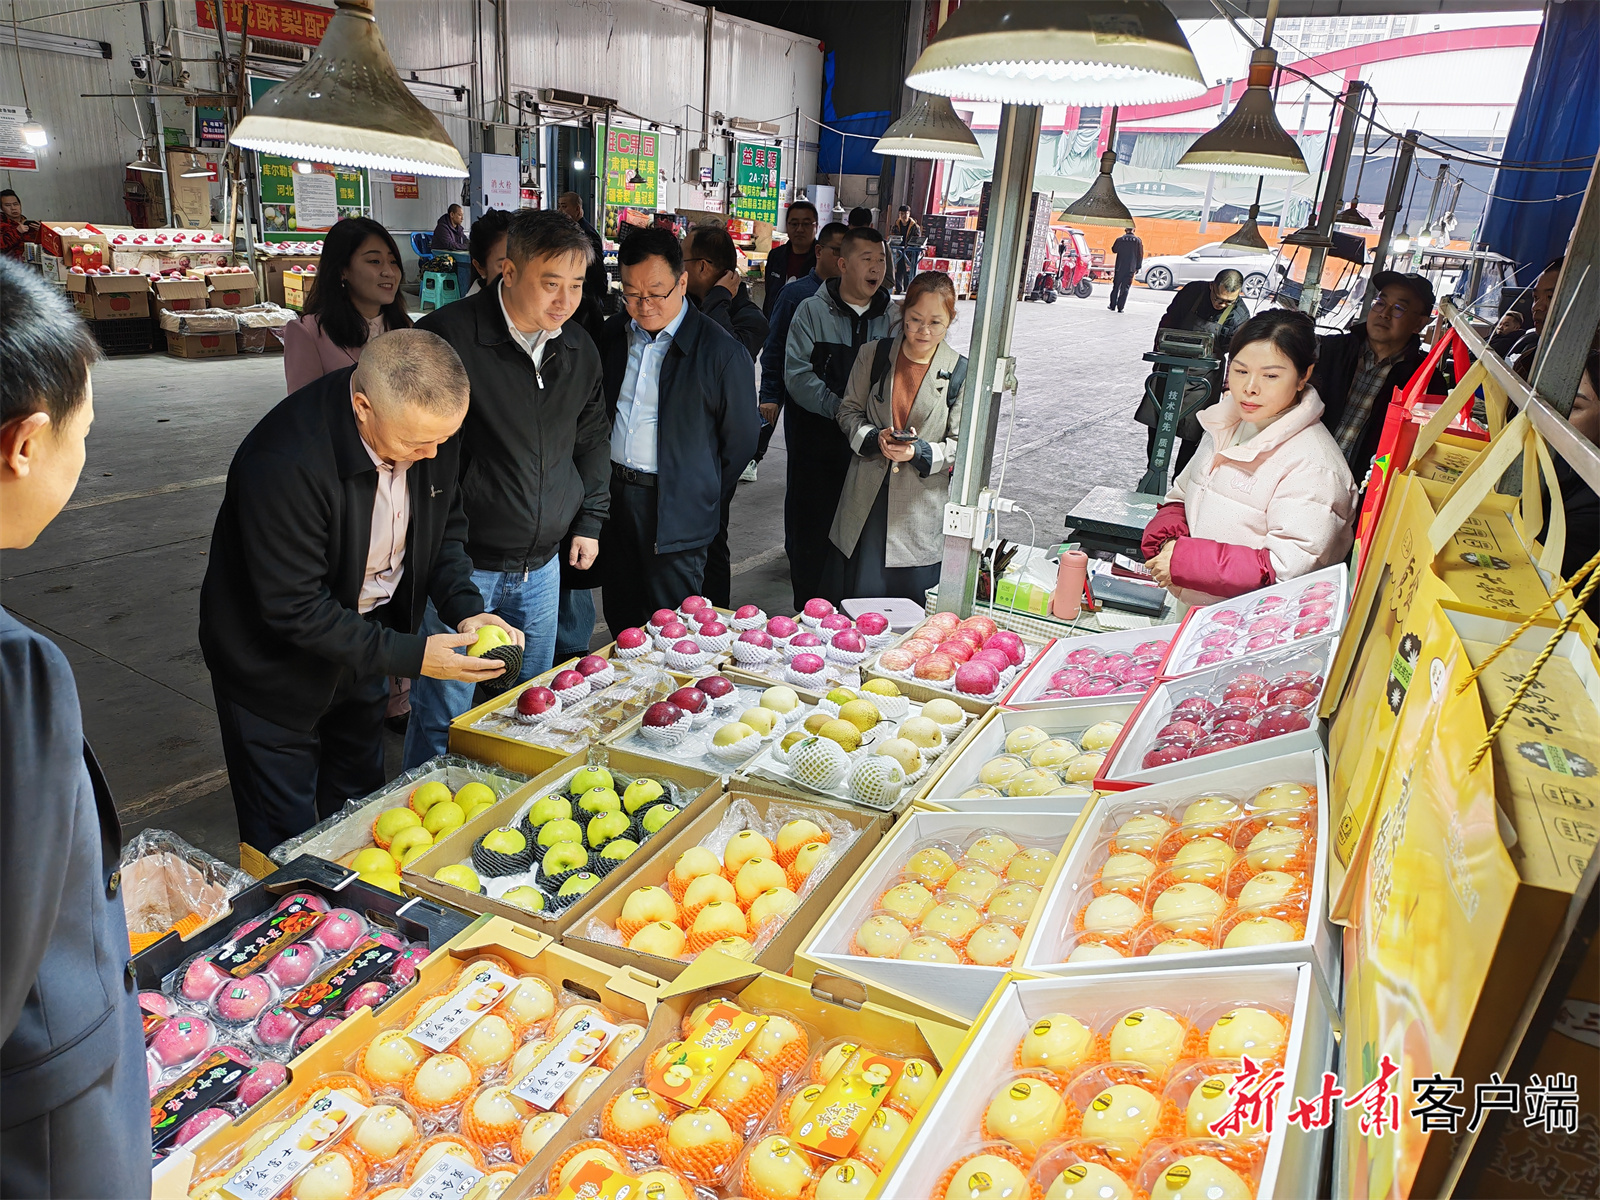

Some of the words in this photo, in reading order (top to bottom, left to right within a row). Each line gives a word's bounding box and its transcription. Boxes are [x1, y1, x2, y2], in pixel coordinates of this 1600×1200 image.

[608, 157, 655, 174] 肃静宁苹果
[743, 147, 777, 169] 益果源
[339, 188, 355, 200] 雪梨
[491, 179, 512, 190] 消火栓
[1162, 390, 1179, 432] 技术领先
[425, 1008, 463, 1039] 黄金富士
[717, 1027, 741, 1050] 黄金
[529, 1060, 566, 1095] 黄金富士
[816, 1101, 842, 1128] 黄金
[243, 1148, 293, 1191] 黄金富士
